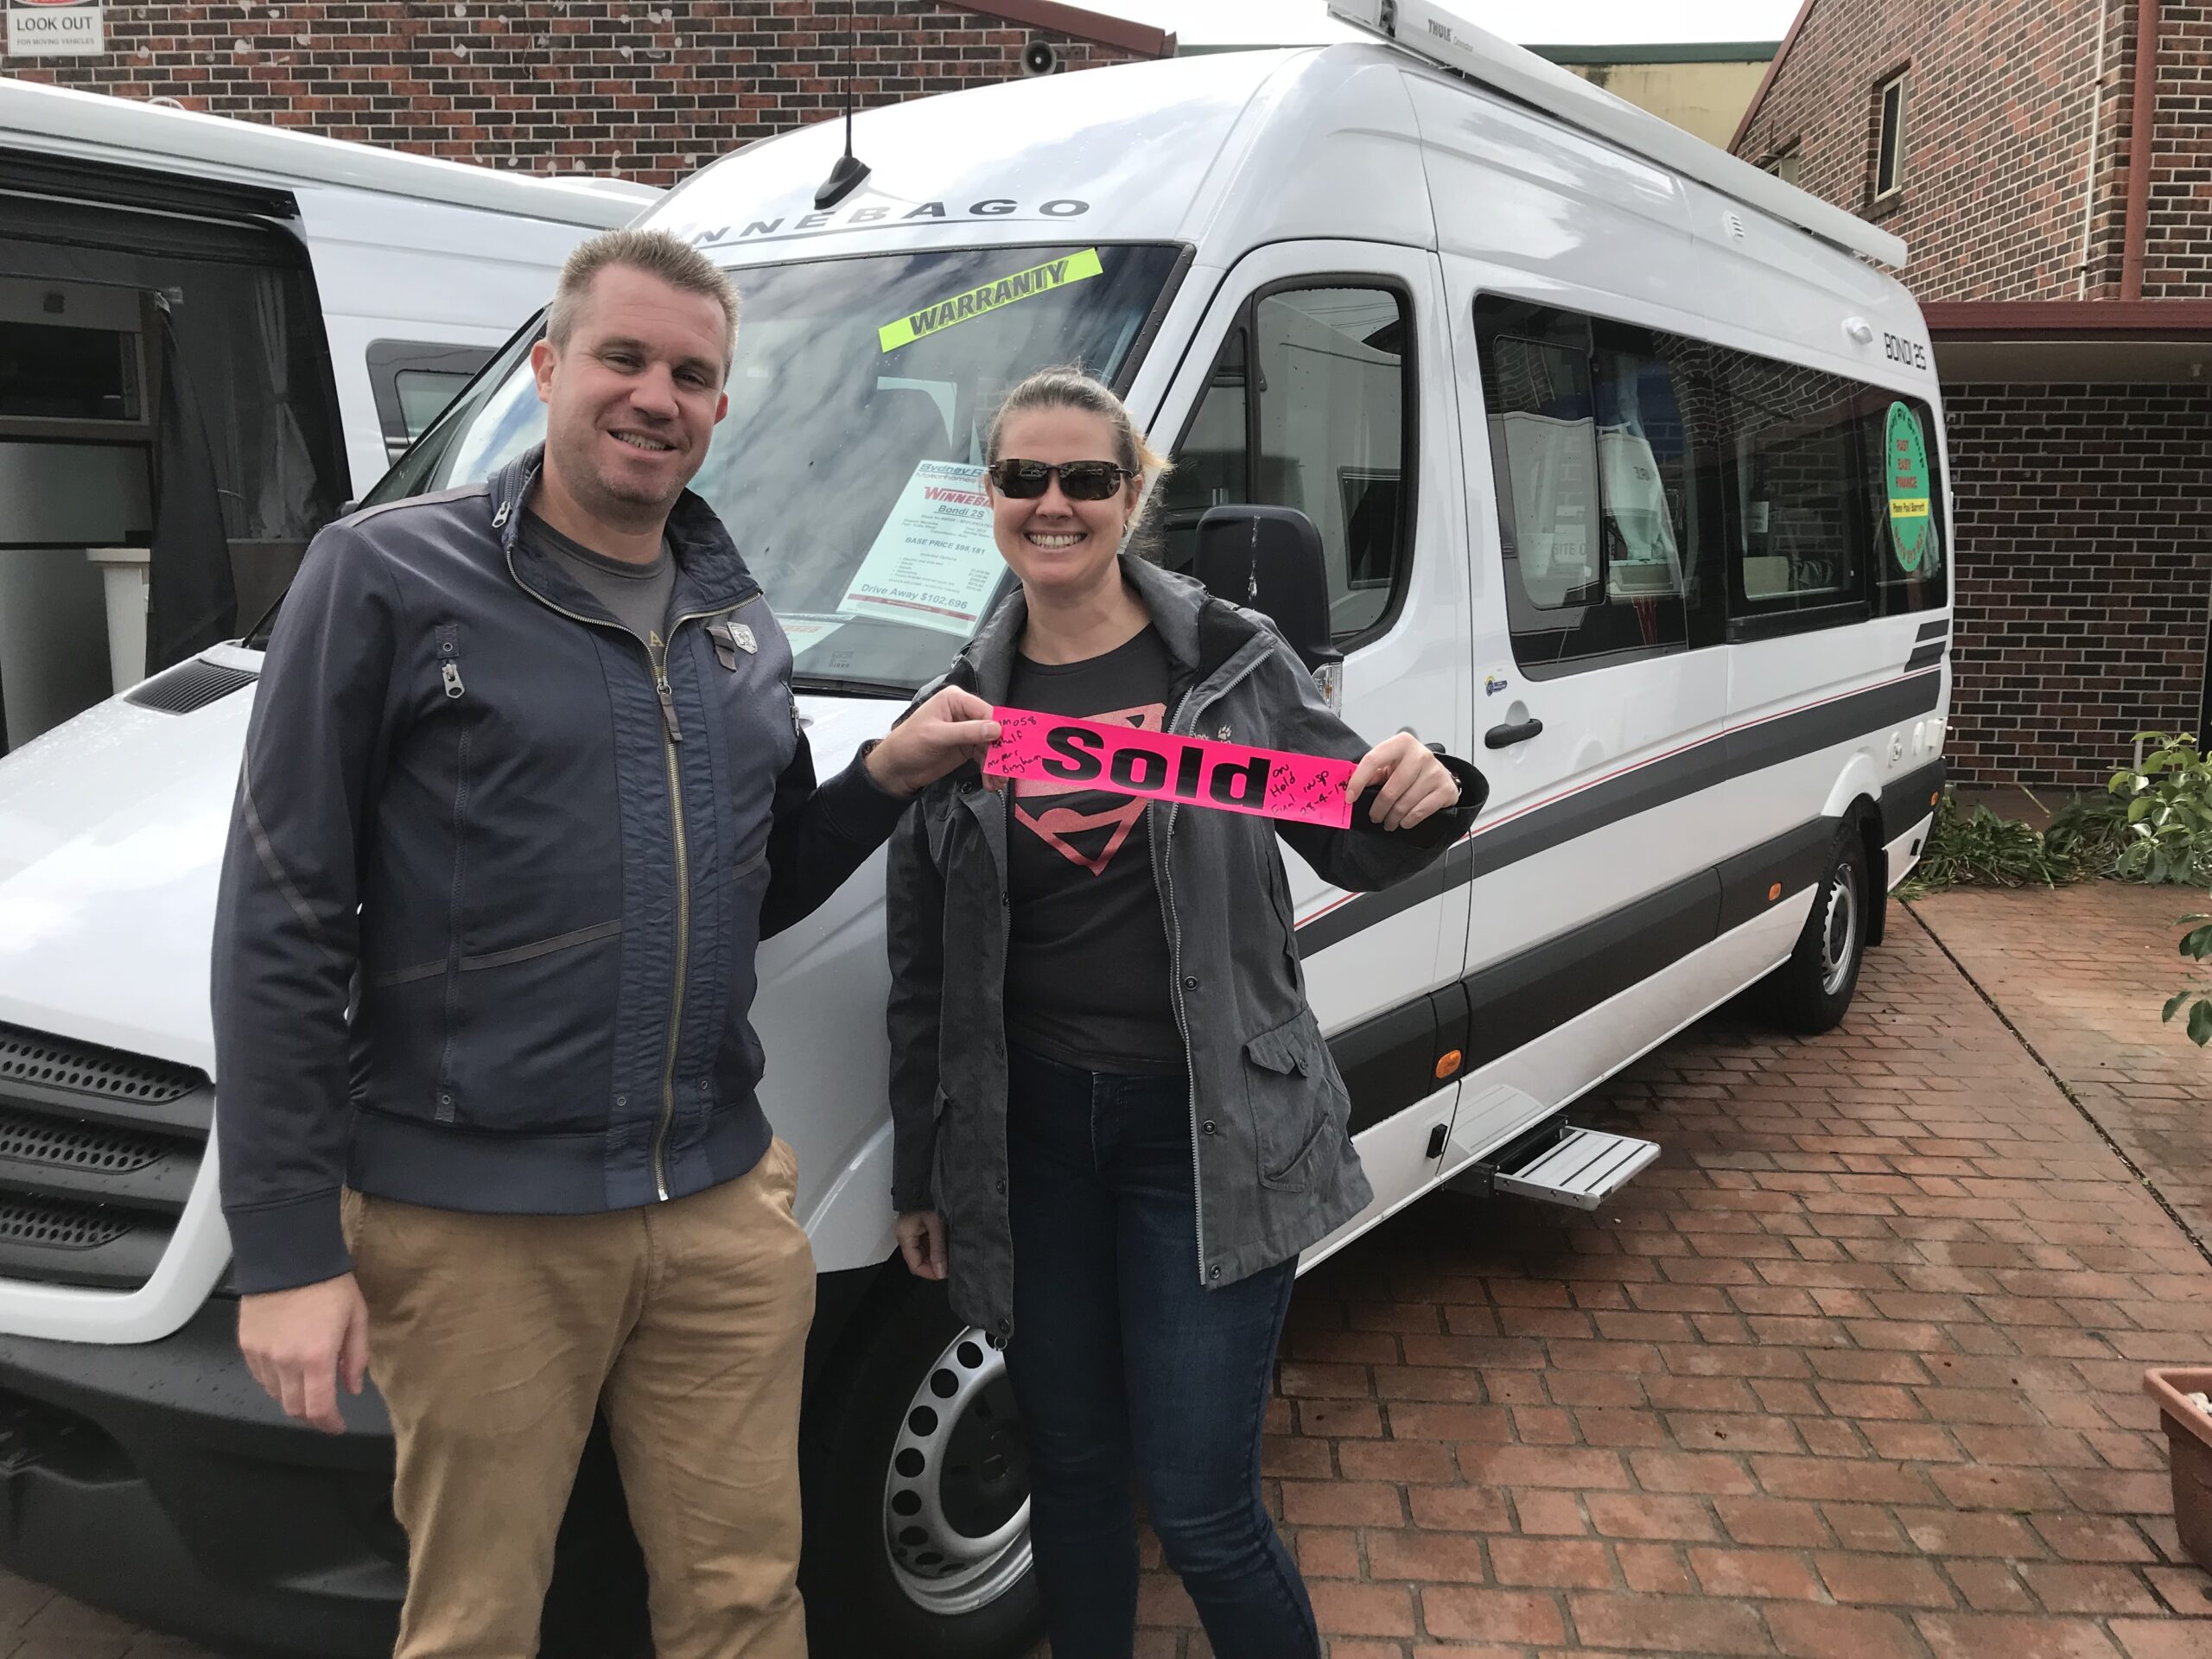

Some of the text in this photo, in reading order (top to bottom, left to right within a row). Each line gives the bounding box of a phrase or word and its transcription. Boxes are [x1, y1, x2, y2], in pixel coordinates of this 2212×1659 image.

[16, 16, 92, 31] LOOK OUT
[1427, 18, 1452, 42] THULE
[908, 258, 1070, 336] WARRANTY
[1884, 332, 1914, 366] BONDI
[915, 472, 976, 484] Motorhomes
[919, 463, 984, 476] Sydney R
[924, 486, 994, 508] WINNEBA
[938, 505, 969, 516] Bondi
[905, 537, 986, 556] BASE PRICE $98,181
[861, 583, 888, 594] Drive
[889, 588, 918, 601] Away
[920, 591, 969, 610] $102,696
[1041, 726, 1272, 810] Sold
[1269, 771, 1296, 798] Hold
